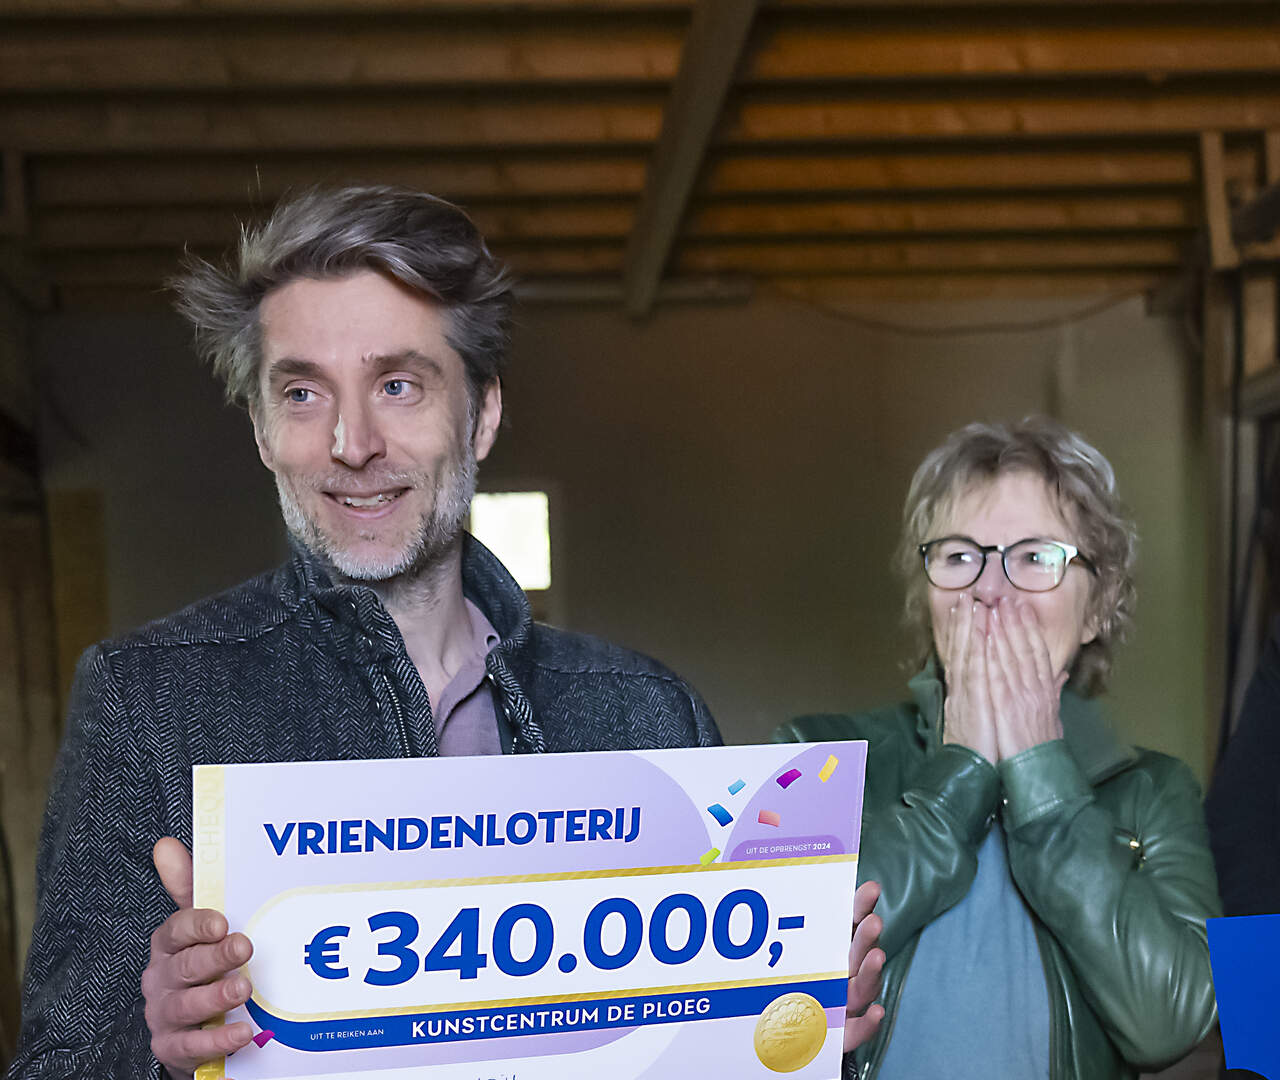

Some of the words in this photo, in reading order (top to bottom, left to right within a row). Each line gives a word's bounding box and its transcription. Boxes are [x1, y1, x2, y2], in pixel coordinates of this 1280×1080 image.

[262, 806, 641, 857] VRIENDENLOTERIJ
[746, 847, 757, 855] UIT
[759, 846, 769, 854] DE
[770, 843, 811, 853] OPBRENGST
[813, 842, 831, 850] 2024
[411, 1007, 599, 1038] KUNSTCENTRUM
[607, 1004, 635, 1022] DE
[642, 997, 711, 1019] PLOEG
[310, 1033, 323, 1041] UIT
[337, 1030, 365, 1038] REIKEN
